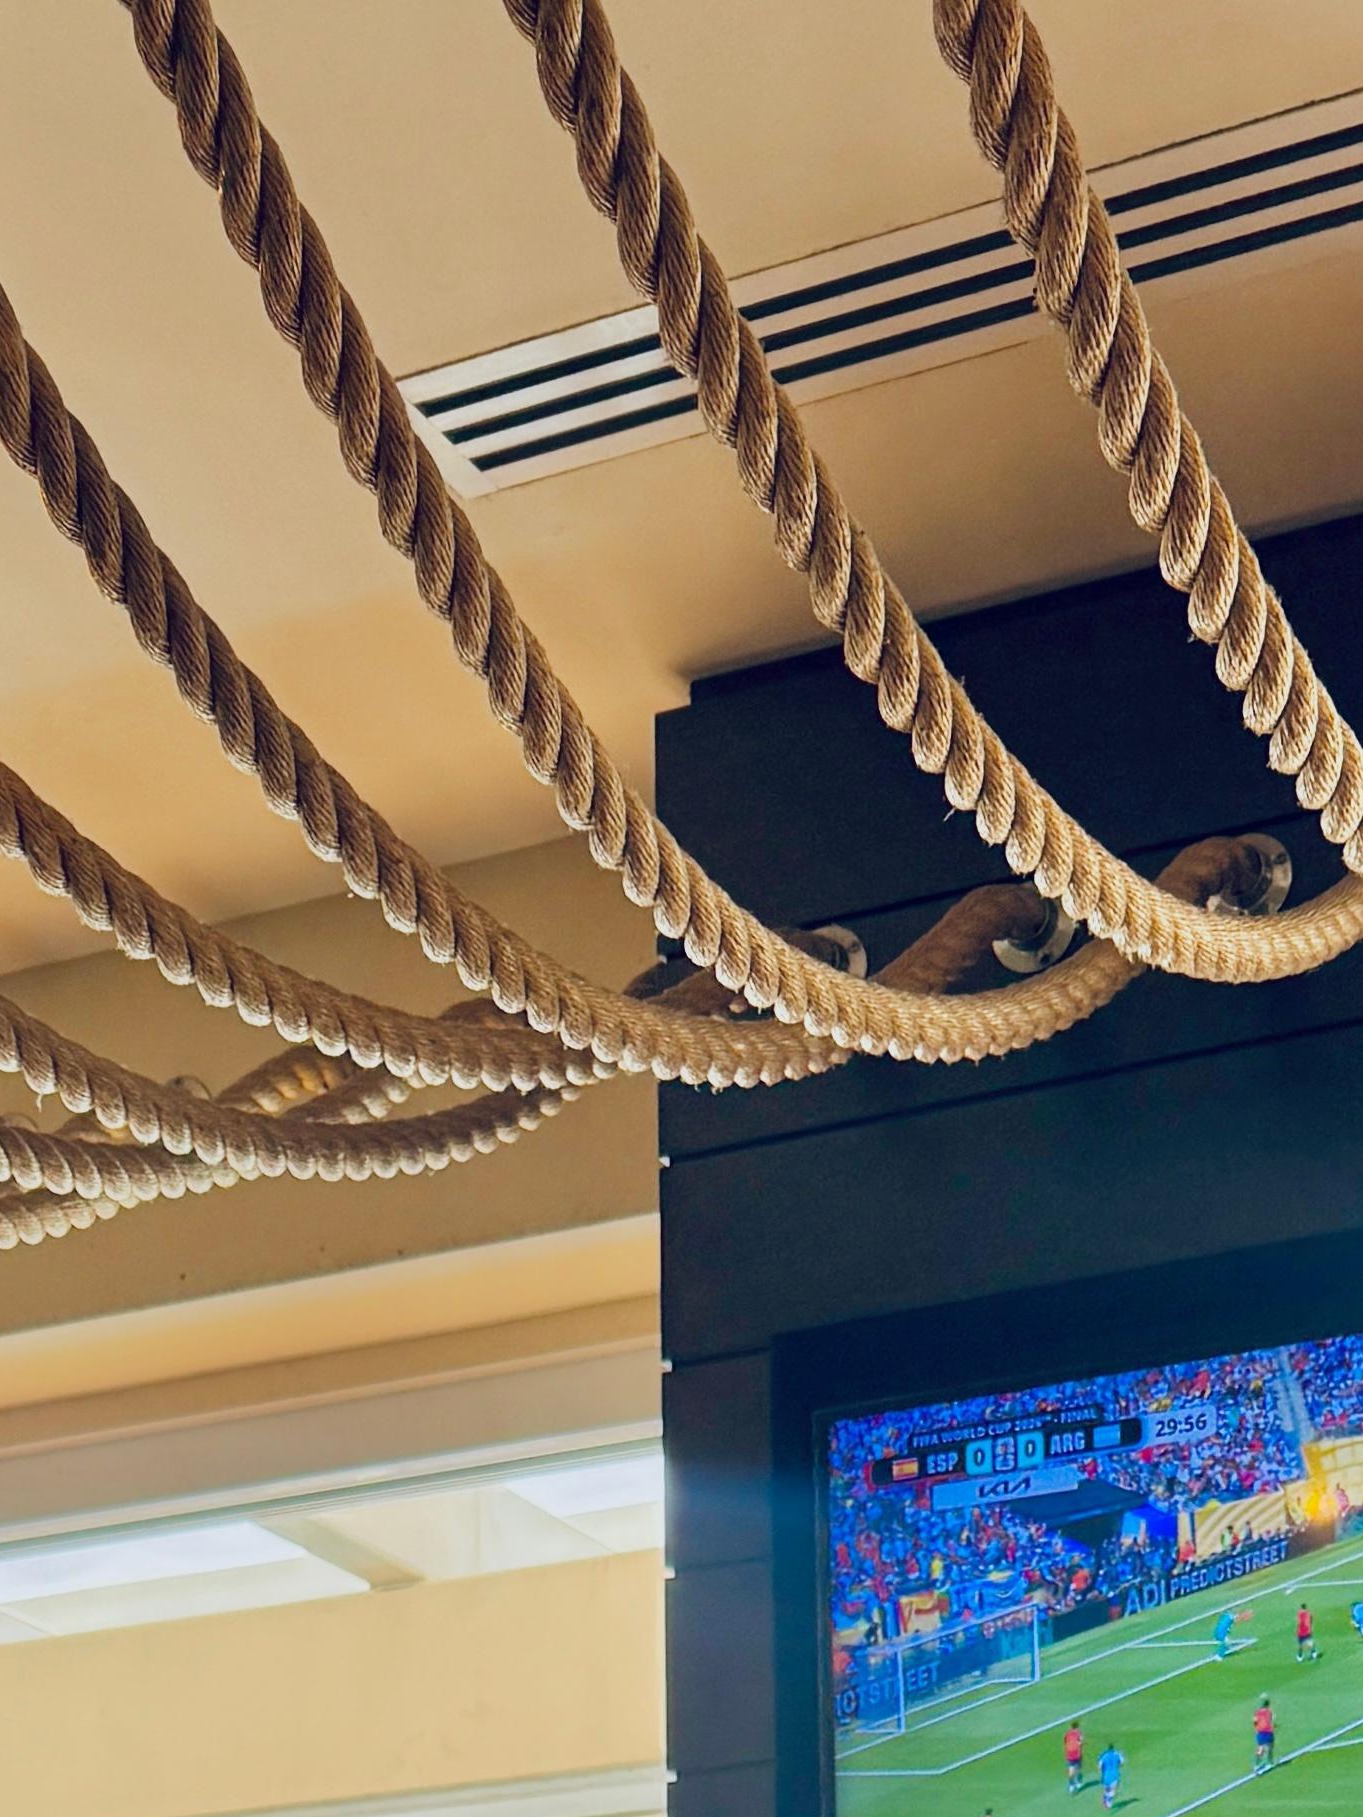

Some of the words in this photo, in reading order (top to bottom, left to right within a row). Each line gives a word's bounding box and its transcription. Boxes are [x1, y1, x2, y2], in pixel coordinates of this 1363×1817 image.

[926, 1452, 959, 1475] ESP
[1050, 1429, 1086, 1455] ARG
[1155, 1412, 1208, 1436] 29:56
[941, 1427, 986, 1443] WORLD
[988, 1422, 1012, 1436] CUP
